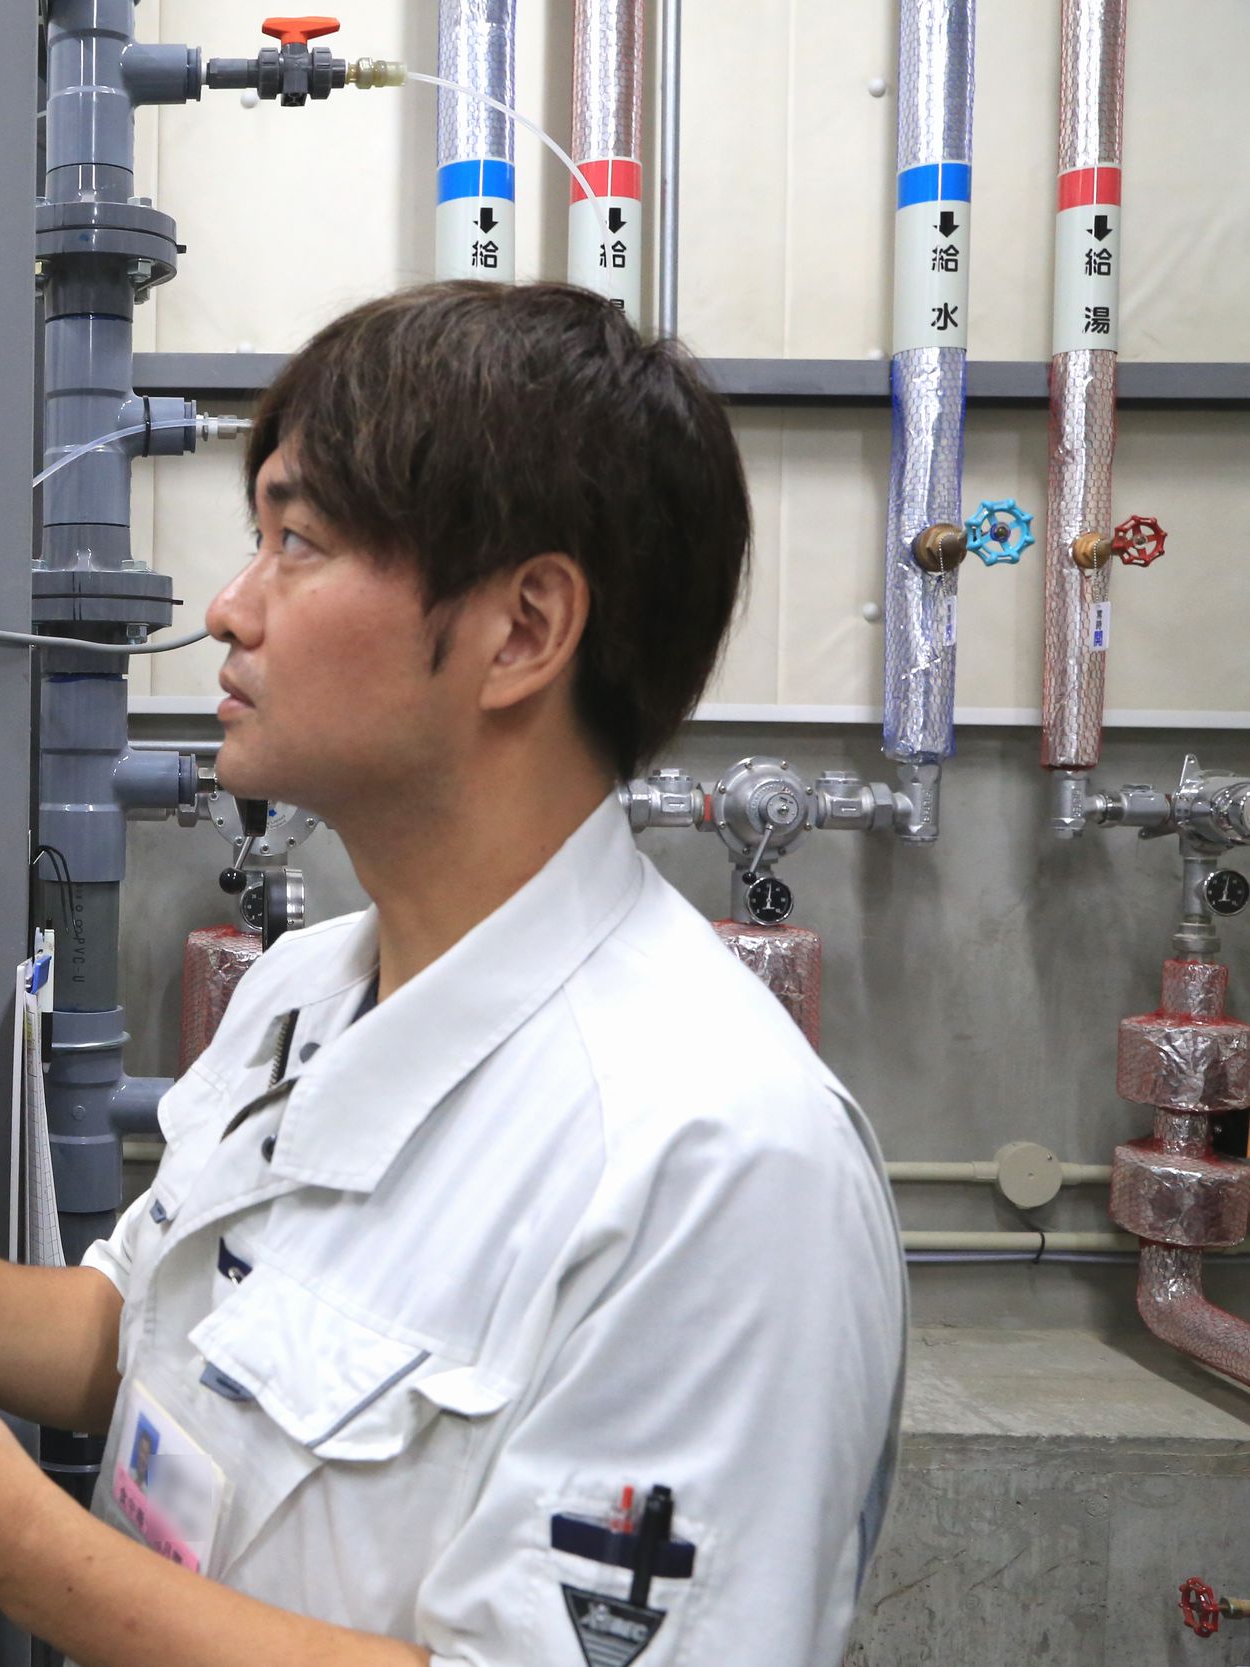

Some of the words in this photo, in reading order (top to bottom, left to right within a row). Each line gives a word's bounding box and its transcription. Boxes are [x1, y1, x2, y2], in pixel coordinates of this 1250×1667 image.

[471, 240, 499, 269] 給
[931, 244, 960, 331] 給水
[1083, 247, 1113, 335] 給湯
